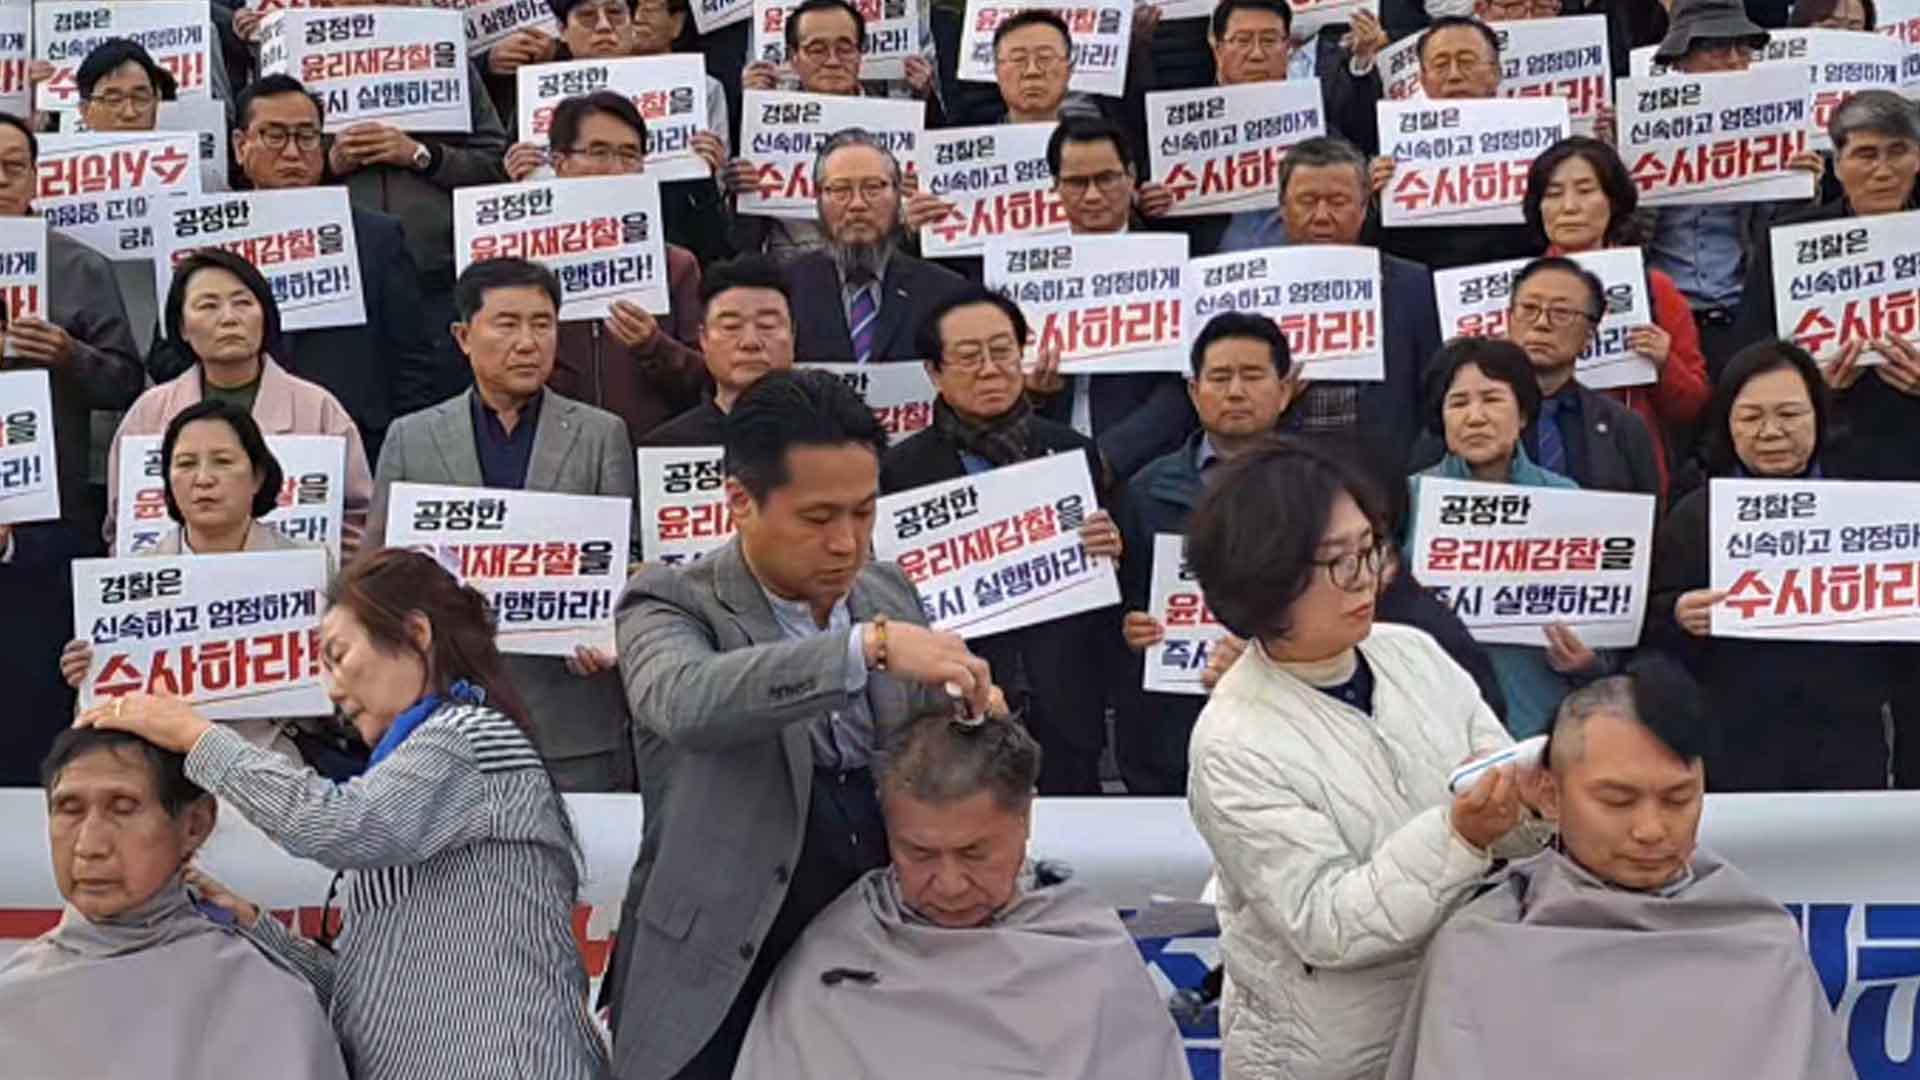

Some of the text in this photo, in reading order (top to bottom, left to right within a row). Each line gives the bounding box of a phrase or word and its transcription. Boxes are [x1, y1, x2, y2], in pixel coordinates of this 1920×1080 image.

[305, 14, 375, 46] 공정한
[301, 41, 456, 82] 윤리재감찰을
[356, 78, 460, 109] 실행하라!
[538, 67, 609, 98] 공정한
[1637, 84, 1701, 112] 경찰은
[761, 103, 821, 125] 경찰은
[1166, 97, 1225, 126] 경찰은
[1399, 108, 1459, 132] 경찰은
[1631, 112, 1712, 144] 신속하고
[1719, 100, 1803, 131] 엄정하게
[1161, 108, 1319, 155] 신속하고 엄정하게
[1392, 124, 1562, 161] 신속하고 엄정하게
[935, 136, 995, 165] 경찰은
[930, 164, 1008, 195] 신속하고
[173, 200, 249, 238] 공정한
[476, 188, 553, 226] 공정한
[1006, 245, 1073, 273] 경찰은
[1796, 229, 1868, 264] 경찰은
[1091, 267, 1180, 297] 엄정하게
[1288, 279, 1373, 305] 엄정하게
[1791, 260, 1886, 300] 신속하고
[413, 500, 506, 531] 공정한
[893, 486, 978, 539] 공정한
[1440, 495, 1531, 525] 공정한
[1737, 492, 1816, 521] 경찰은
[897, 494, 1083, 583] 윤리재감찰을
[1427, 537, 1635, 572] 윤리재감찰을
[1726, 529, 1831, 559] 신속하고
[100, 568, 182, 604] 경찰은
[1493, 584, 1631, 616] 실행하라!
[91, 590, 316, 644] 신속하고 엄정하게
[94, 627, 322, 698] 수사하라!
